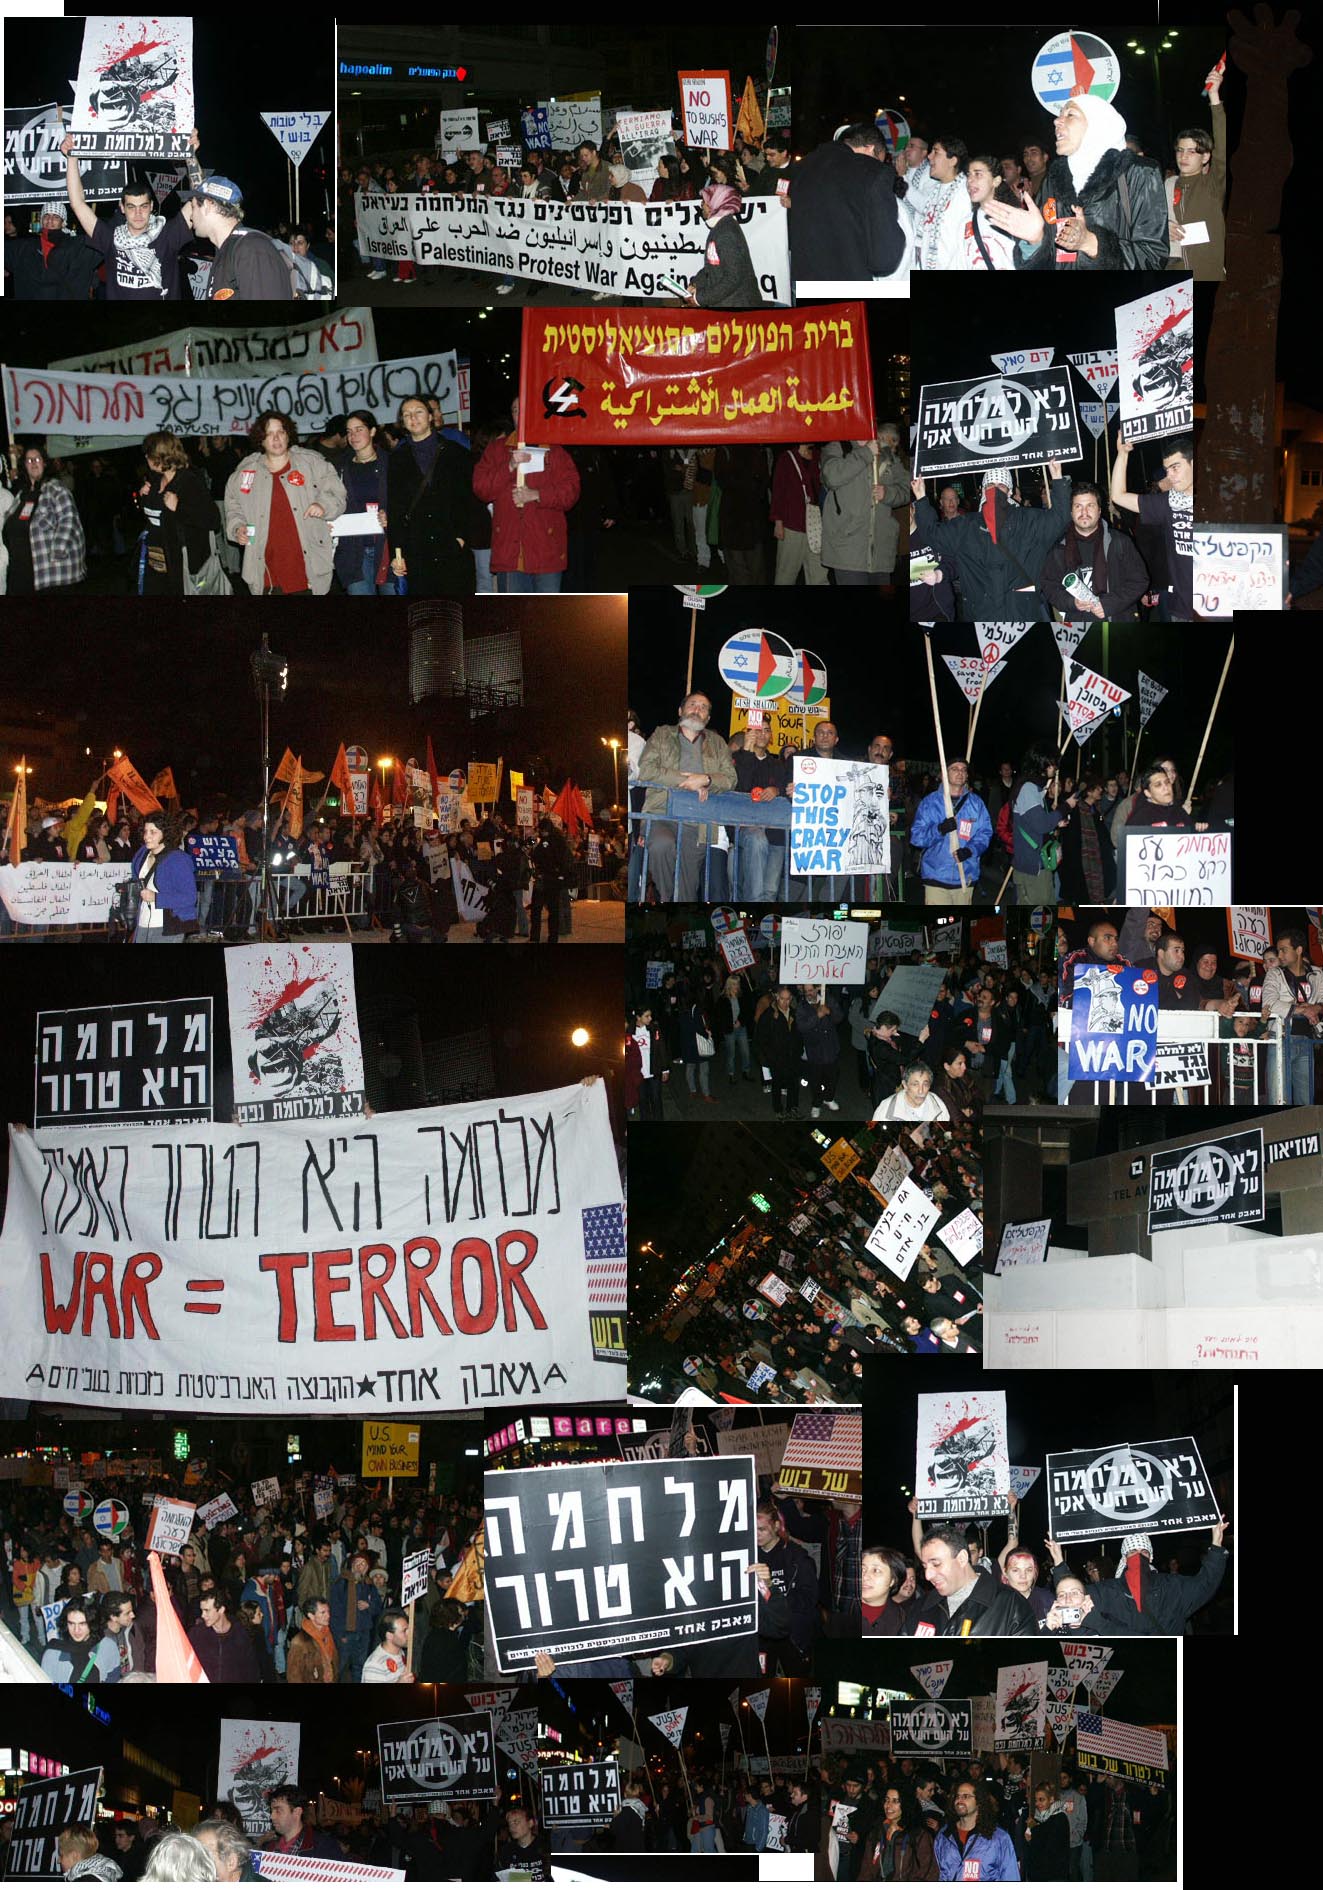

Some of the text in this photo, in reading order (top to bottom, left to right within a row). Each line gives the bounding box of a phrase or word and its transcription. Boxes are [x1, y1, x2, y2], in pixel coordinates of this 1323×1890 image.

[339, 62, 392, 76] hapoalim
[689, 91, 711, 107] NO
[634, 119, 666, 131] GUERRA
[686, 111, 727, 128] TO BUSH'S
[104, 133, 164, 151] למלחמת
[525, 136, 550, 150] WAR
[690, 129, 719, 146] WAR
[361, 195, 633, 226] ופלסטינים נגד המלחמה בעיראק
[378, 216, 520, 241] ضد الحرب على العراق
[367, 236, 618, 287] Israelis Palestinians Protest War
[319, 313, 364, 354] לא
[542, 318, 854, 357] ברית הפועלים הסוציאליסטית
[1030, 351, 1049, 363] דם
[1072, 351, 1101, 366] בוש
[151, 384, 201, 424] נגד
[723, 374, 855, 426] عصبة العمال
[924, 384, 1066, 426] לא למלחמה
[1047, 411, 1071, 433] על
[1122, 418, 1148, 437] נפט
[1022, 447, 1078, 460] מאבק אחד
[1055, 628, 1081, 645] הורג
[1084, 673, 1123, 702] שרון
[734, 698, 751, 707] GUSH
[788, 706, 807, 714] שלום
[749, 710, 763, 720] NO
[777, 713, 804, 729] YOUR
[793, 782, 847, 806] STOP
[792, 806, 839, 827] THIS
[202, 837, 230, 846] בוש
[791, 828, 850, 850] CRAZY
[1138, 833, 1229, 861] מלחמה על
[200, 848, 236, 858] מצית
[793, 849, 843, 873] WAR
[196, 858, 238, 869] מלחמה
[1198, 859, 1227, 880] רקע
[1237, 913, 1265, 935] רעה
[784, 943, 820, 966] התיכון
[1250, 987, 1262, 997] NO
[1128, 1003, 1159, 1034] NO
[42, 1012, 207, 1064] מלחמה
[1075, 1039, 1151, 1074] WAR
[1188, 1043, 1201, 1054] לא
[1178, 1055, 1207, 1068] נגד
[41, 1064, 207, 1112] היא טרור
[237, 1091, 364, 1121] לא למלחמת נפט
[1268, 1135, 1318, 1165] מוזיאון
[152, 1108, 561, 1241] מלחמה היא הטרור
[1153, 1149, 1258, 1191] לא למלחמה
[1113, 1189, 1132, 1201] TEL
[1240, 1175, 1259, 1195] על
[897, 1189, 911, 1204] גם
[1219, 1208, 1261, 1221] מאבק אחד
[895, 1236, 914, 1264] אדם
[39, 1251, 163, 1340] WAR
[258, 1229, 549, 1343] TERROR
[592, 1317, 626, 1350] בוש
[49, 1365, 78, 1391] חיים
[82, 1367, 111, 1395] בעלי
[175, 1373, 277, 1401] האנרכיסטית
[377, 1366, 442, 1402] אחד
[460, 1362, 541, 1405] מאבק
[287, 1375, 354, 1402] הקבוצה
[557, 1418, 630, 1434] care
[366, 1445, 387, 1457] MIND
[368, 1460, 388, 1473] OWN
[1022, 1467, 1038, 1477] דם
[1053, 1454, 1198, 1493] לא למלחמה
[779, 1467, 849, 1492] של בוש
[1179, 1480, 1206, 1499] על
[917, 1494, 1009, 1514] לא למלחמת נפט
[484, 1476, 749, 1558] מלחמה
[1161, 1514, 1217, 1527] מאבק אחד
[495, 1549, 751, 1630] היא טרור
[674, 1620, 707, 1636] אחד
[711, 1614, 752, 1631] מאבק
[935, 1663, 950, 1674] דם
[1068, 1659, 1095, 1671] הורג
[656, 1712, 678, 1726] JUST
[893, 1711, 969, 1728] לא למלחמה
[958, 1729, 969, 1741] על
[383, 1730, 488, 1762] לא למלחמה
[472, 1756, 491, 1773] על
[1078, 1752, 1098, 1769] בוש
[1102, 1757, 1119, 1773] של
[543, 1768, 618, 1793] מלחמה
[1123, 1763, 1151, 1780] לטרור
[1154, 1769, 1165, 1783] די
[16, 1783, 96, 1829] מלחמה
[545, 1792, 618, 1816] היא טרור
[964, 1860, 980, 1875] NO
